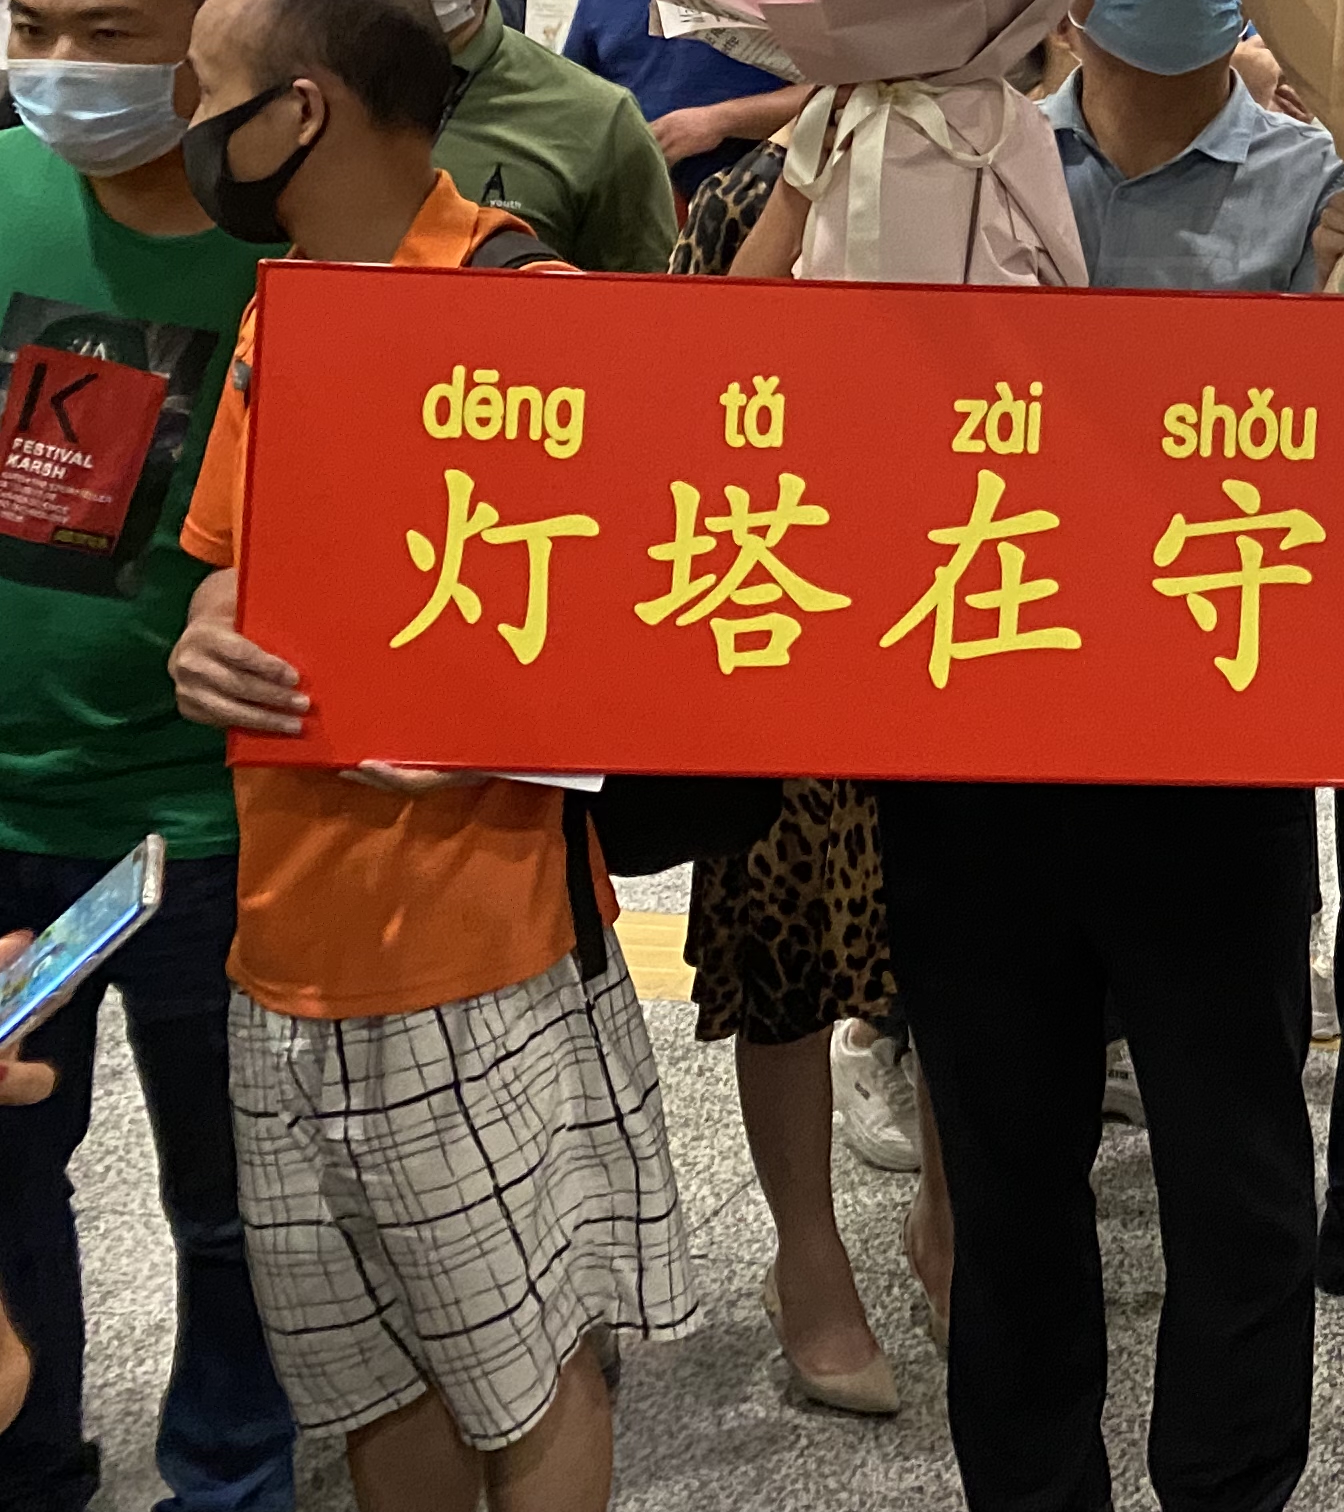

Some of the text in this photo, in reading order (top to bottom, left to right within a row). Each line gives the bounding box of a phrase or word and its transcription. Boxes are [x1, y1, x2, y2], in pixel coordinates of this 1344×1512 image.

[18, 361, 99, 445] K
[423, 365, 585, 459] dēng
[1162, 386, 1317, 460] shǒu
[11, 437, 95, 469] FESTIVAL
